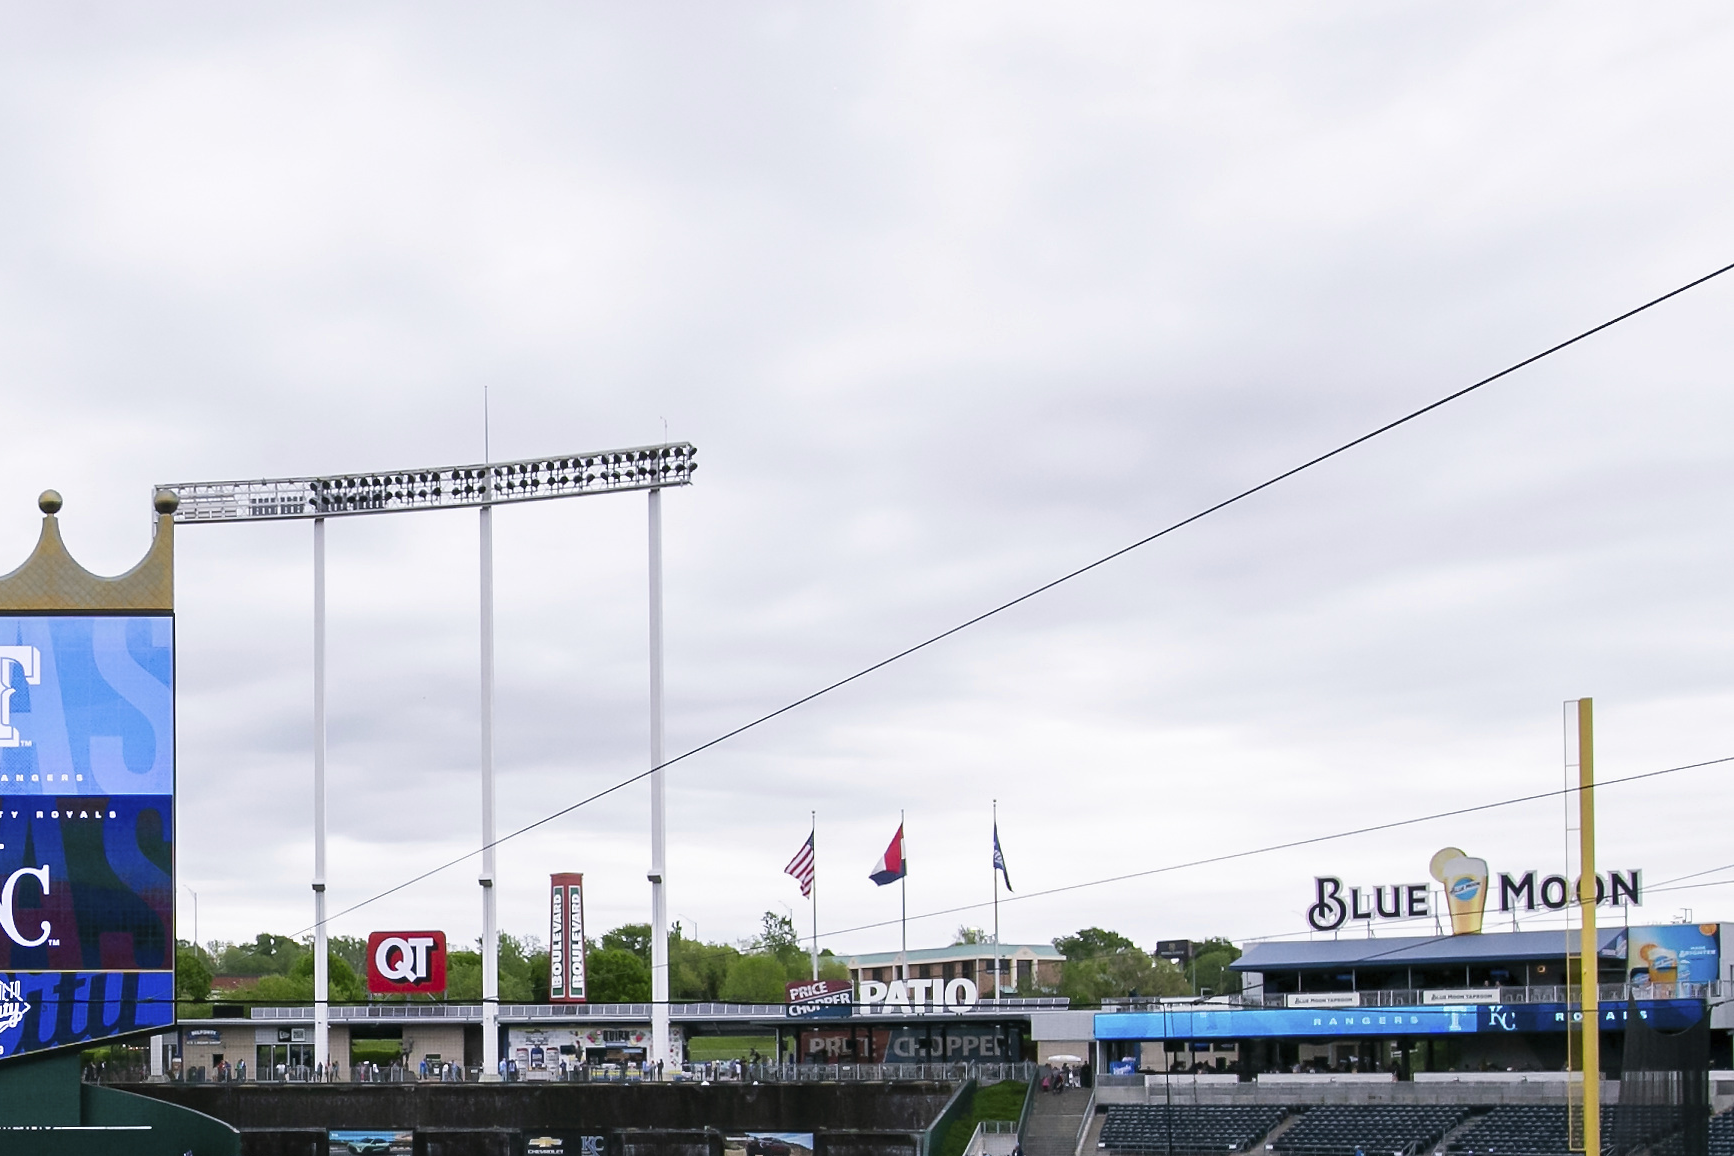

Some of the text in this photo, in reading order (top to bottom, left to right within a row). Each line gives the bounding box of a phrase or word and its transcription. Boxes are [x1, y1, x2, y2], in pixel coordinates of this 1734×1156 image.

[35, 810, 117, 819] ROYALS
[1308, 877, 1428, 931] BLUE
[1499, 869, 1642, 911] MOON
[552, 894, 563, 988] BOULEVARD
[570, 893, 584, 988] BOULEVARD
[375, 936, 435, 983] QT
[10, 980, 20, 999] TO
[788, 992, 851, 1016] CHOPPER
[789, 981, 827, 1000] PRICE
[859, 977, 978, 1014] PATIO
[1313, 1015, 1419, 1026] RANGERS
